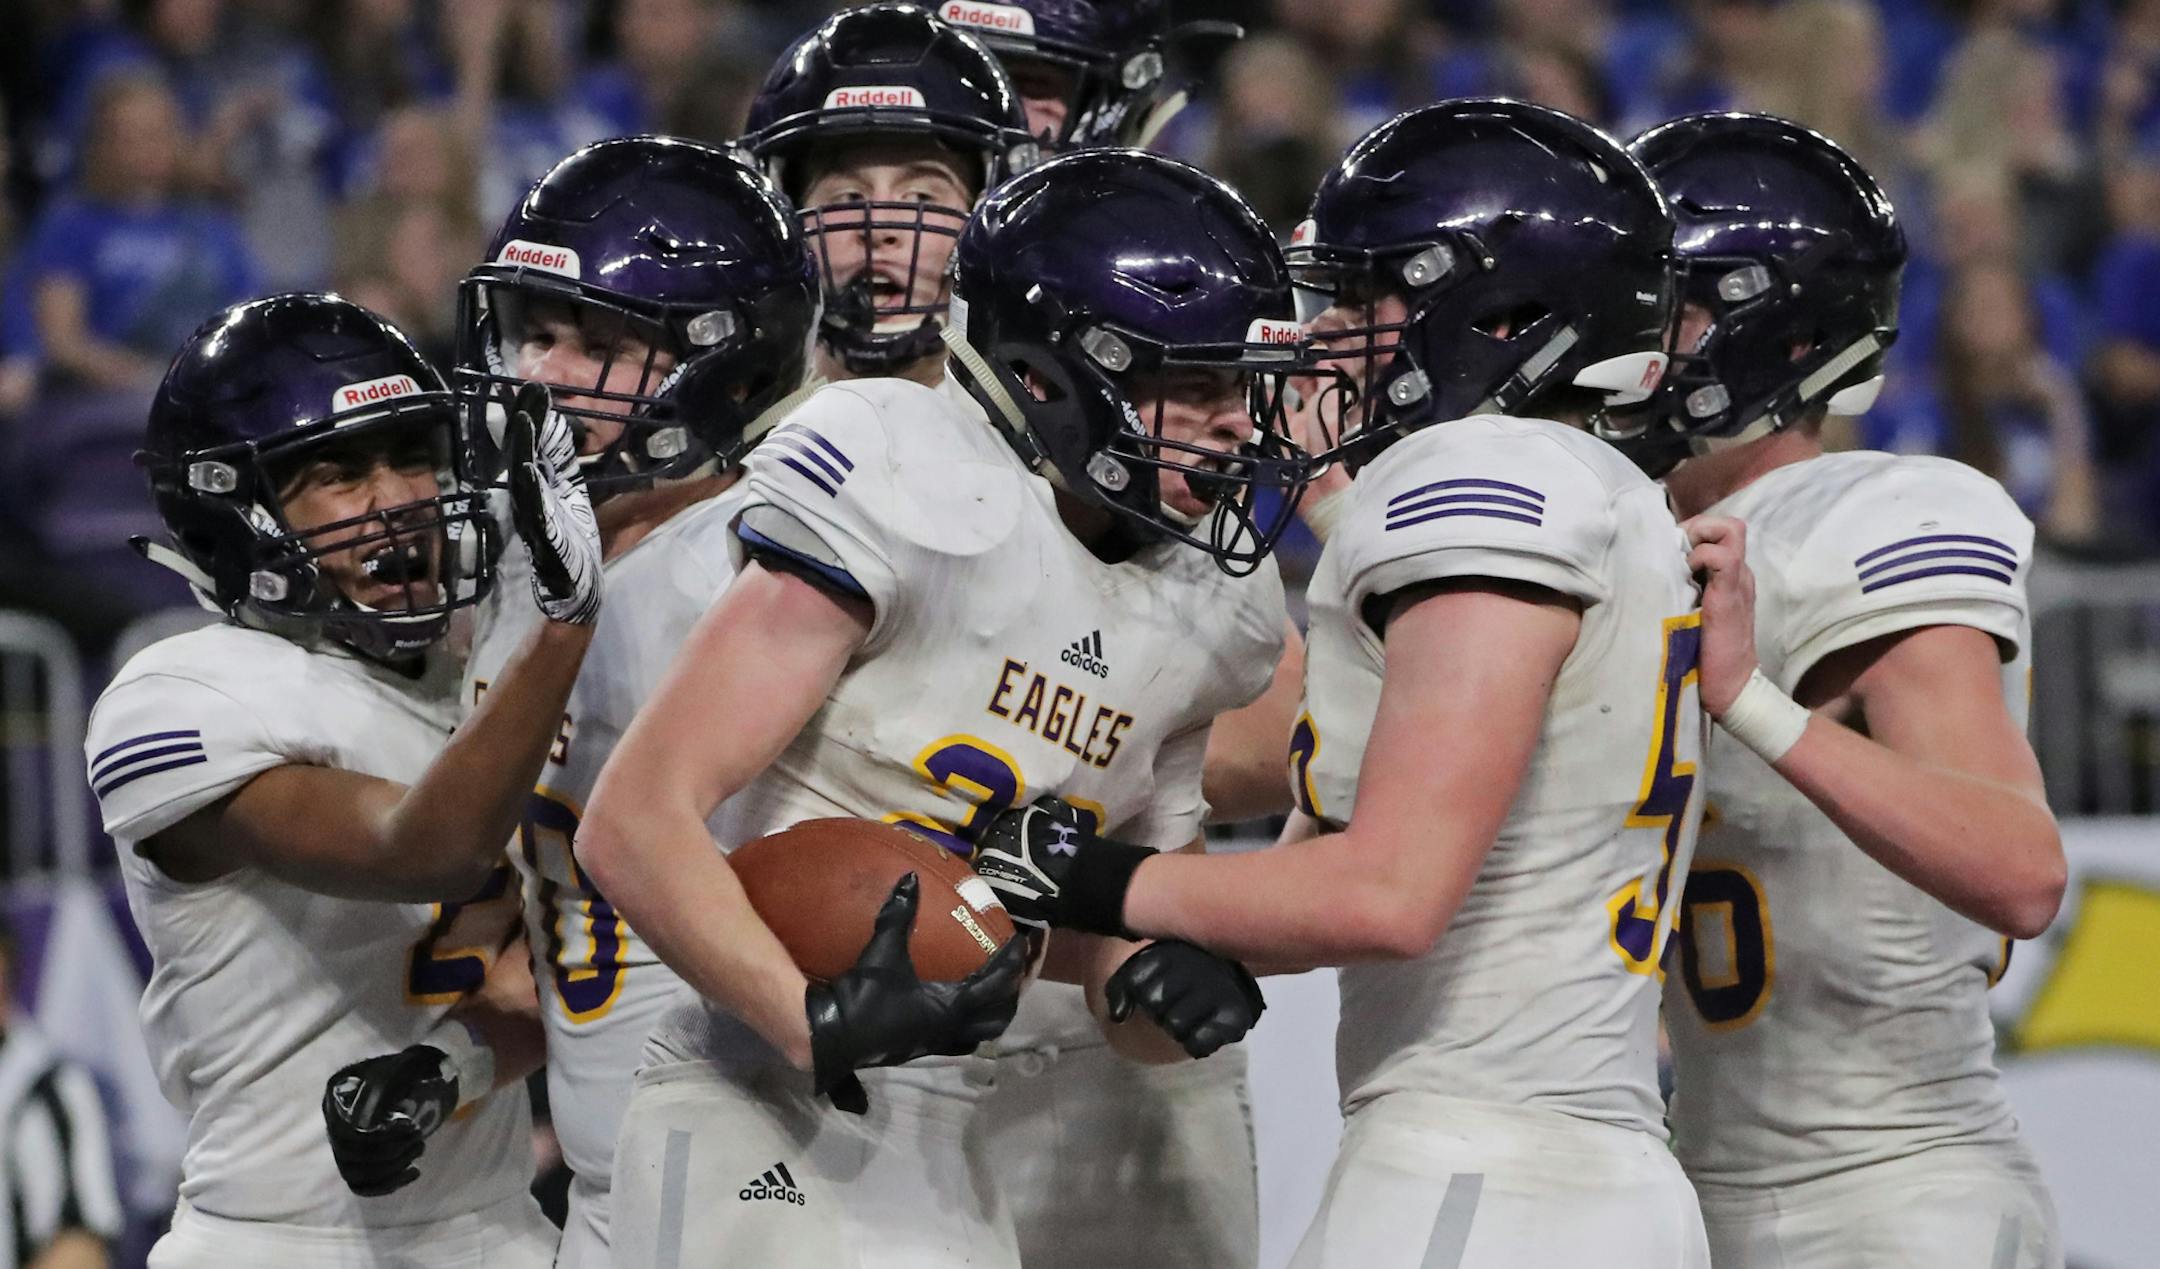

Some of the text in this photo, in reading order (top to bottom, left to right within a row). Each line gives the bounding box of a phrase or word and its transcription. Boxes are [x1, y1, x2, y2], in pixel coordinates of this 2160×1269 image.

[947, 4, 1020, 29] Riddell
[836, 90, 913, 106] Riddell
[343, 378, 413, 406] Riddell
[1060, 648, 1110, 679] adidas
[985, 656, 1134, 769] EAGLES
[739, 1185, 806, 1207] adidas
